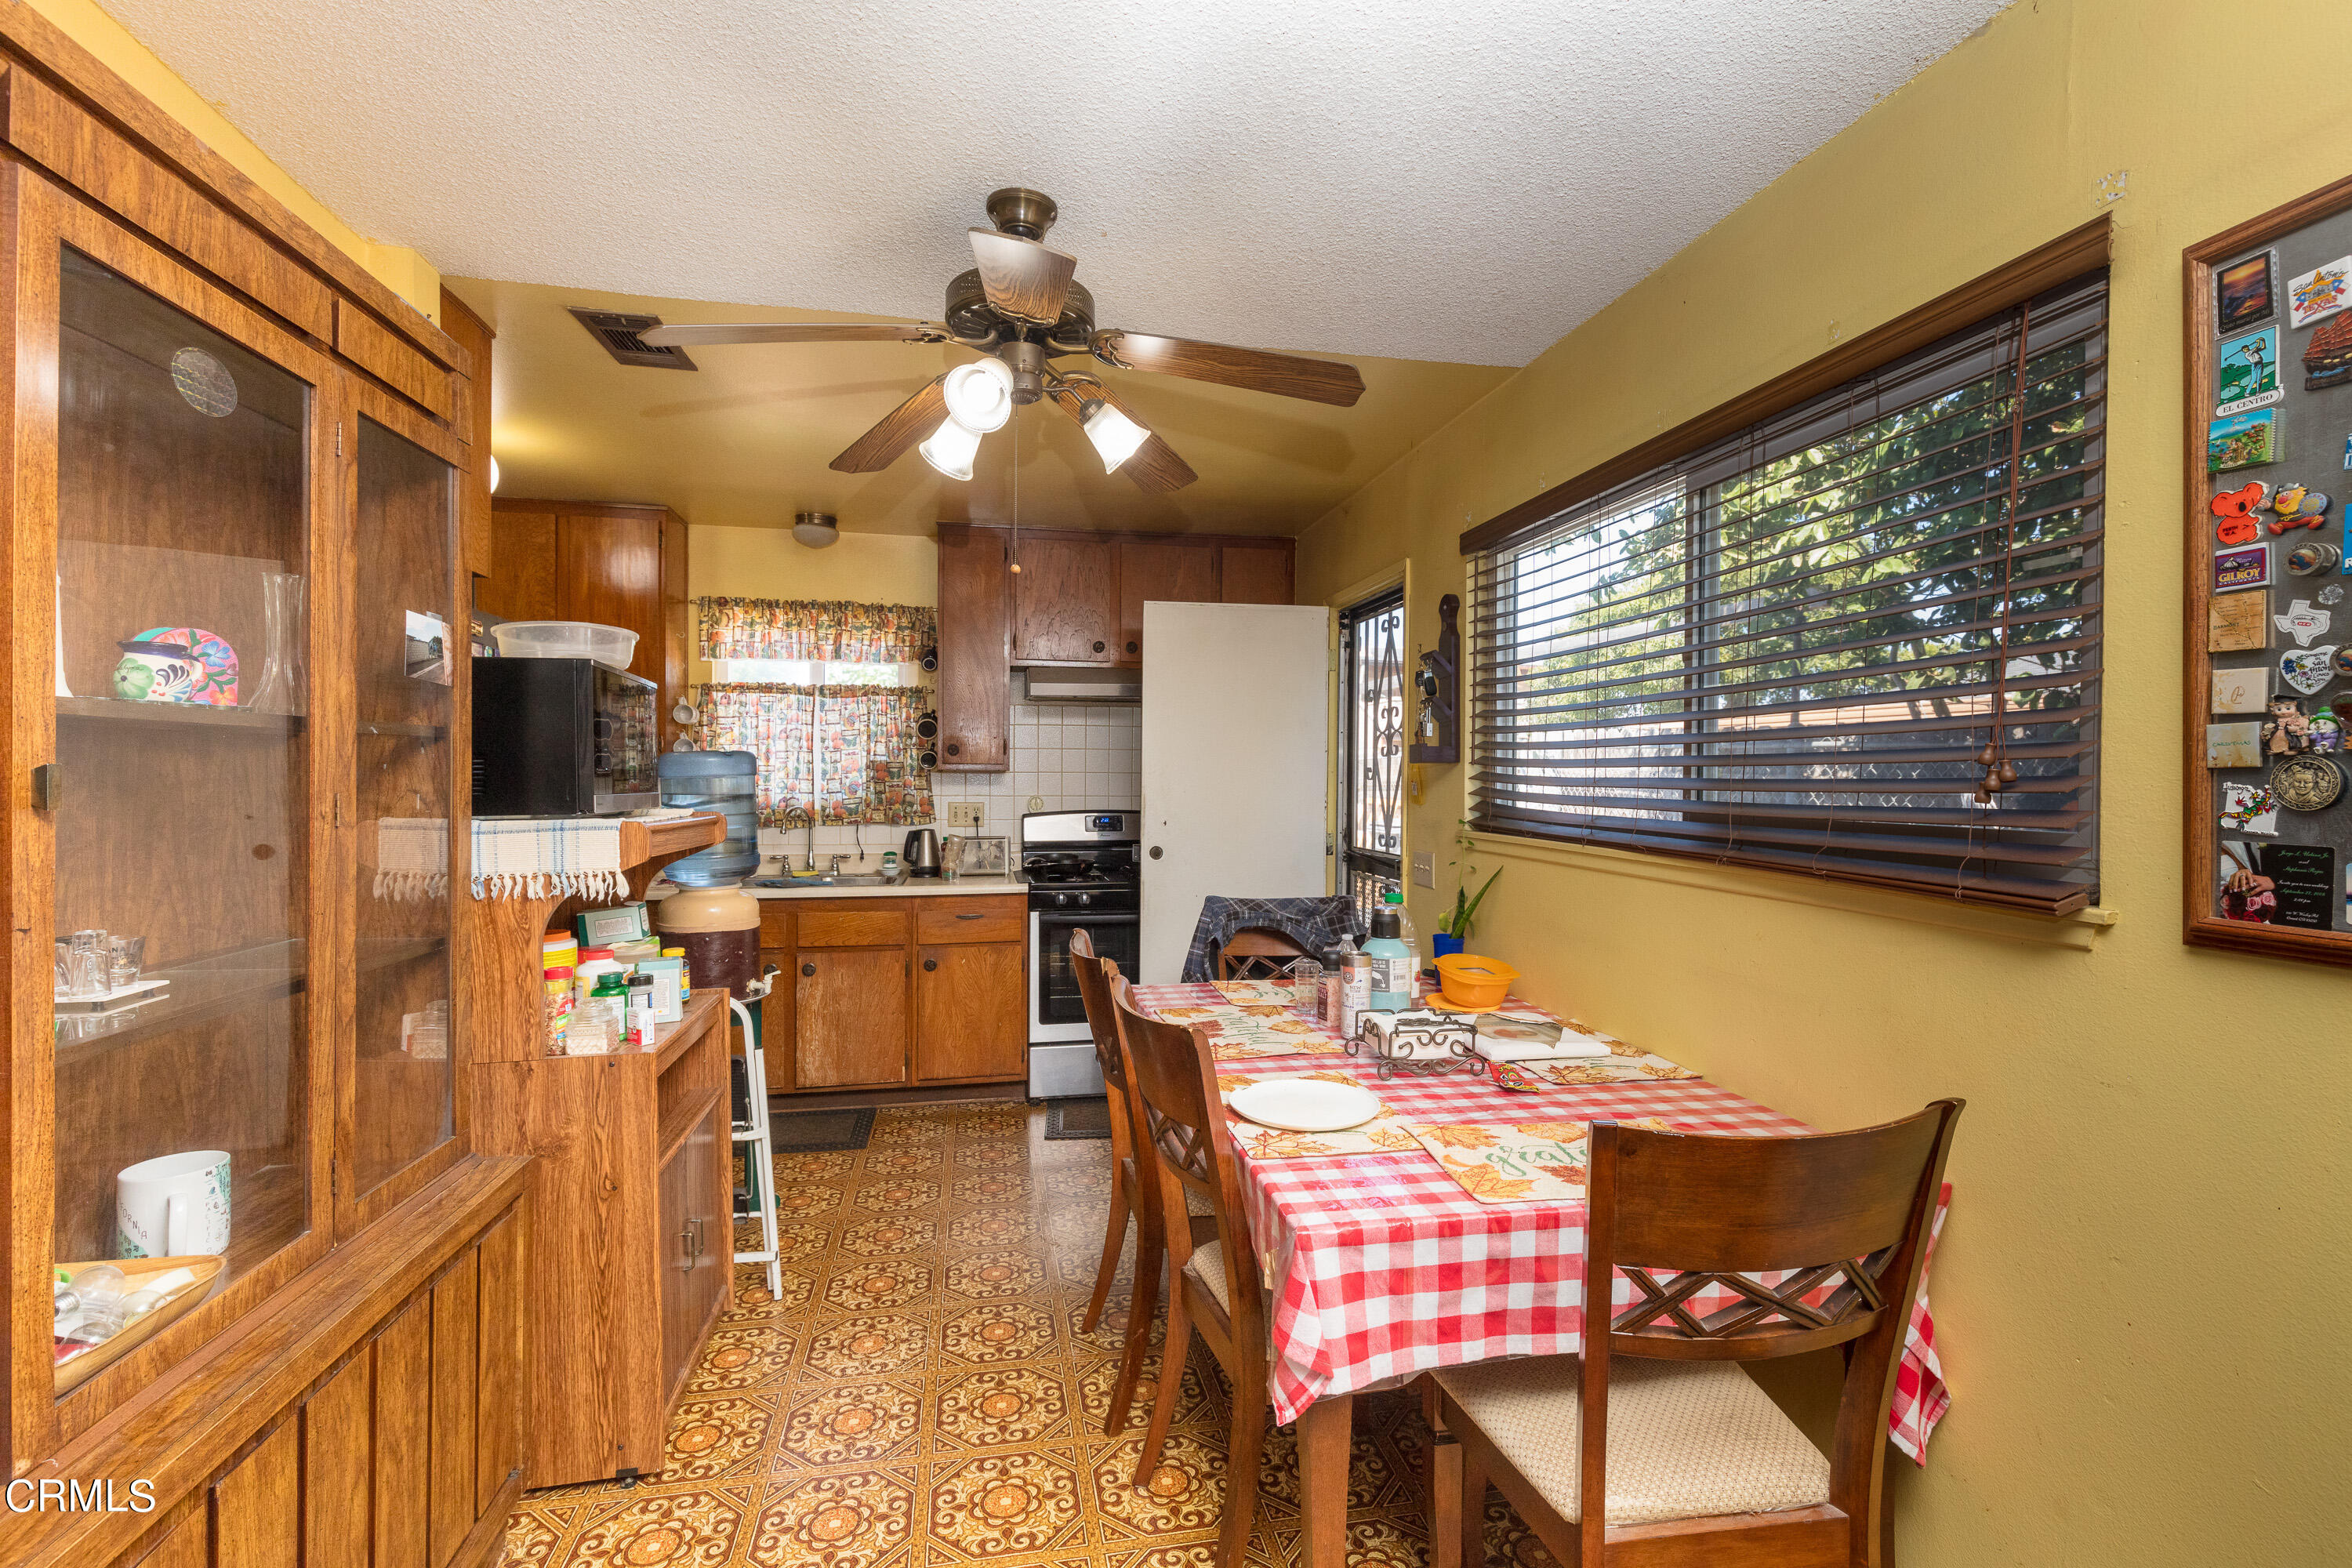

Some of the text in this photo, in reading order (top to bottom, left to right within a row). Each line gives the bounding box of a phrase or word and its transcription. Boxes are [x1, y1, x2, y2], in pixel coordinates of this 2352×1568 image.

[2303, 295, 2338, 314] TEXAS
[2237, 394, 2273, 408] CENTRO
[2218, 568, 2261, 583] GILROY
